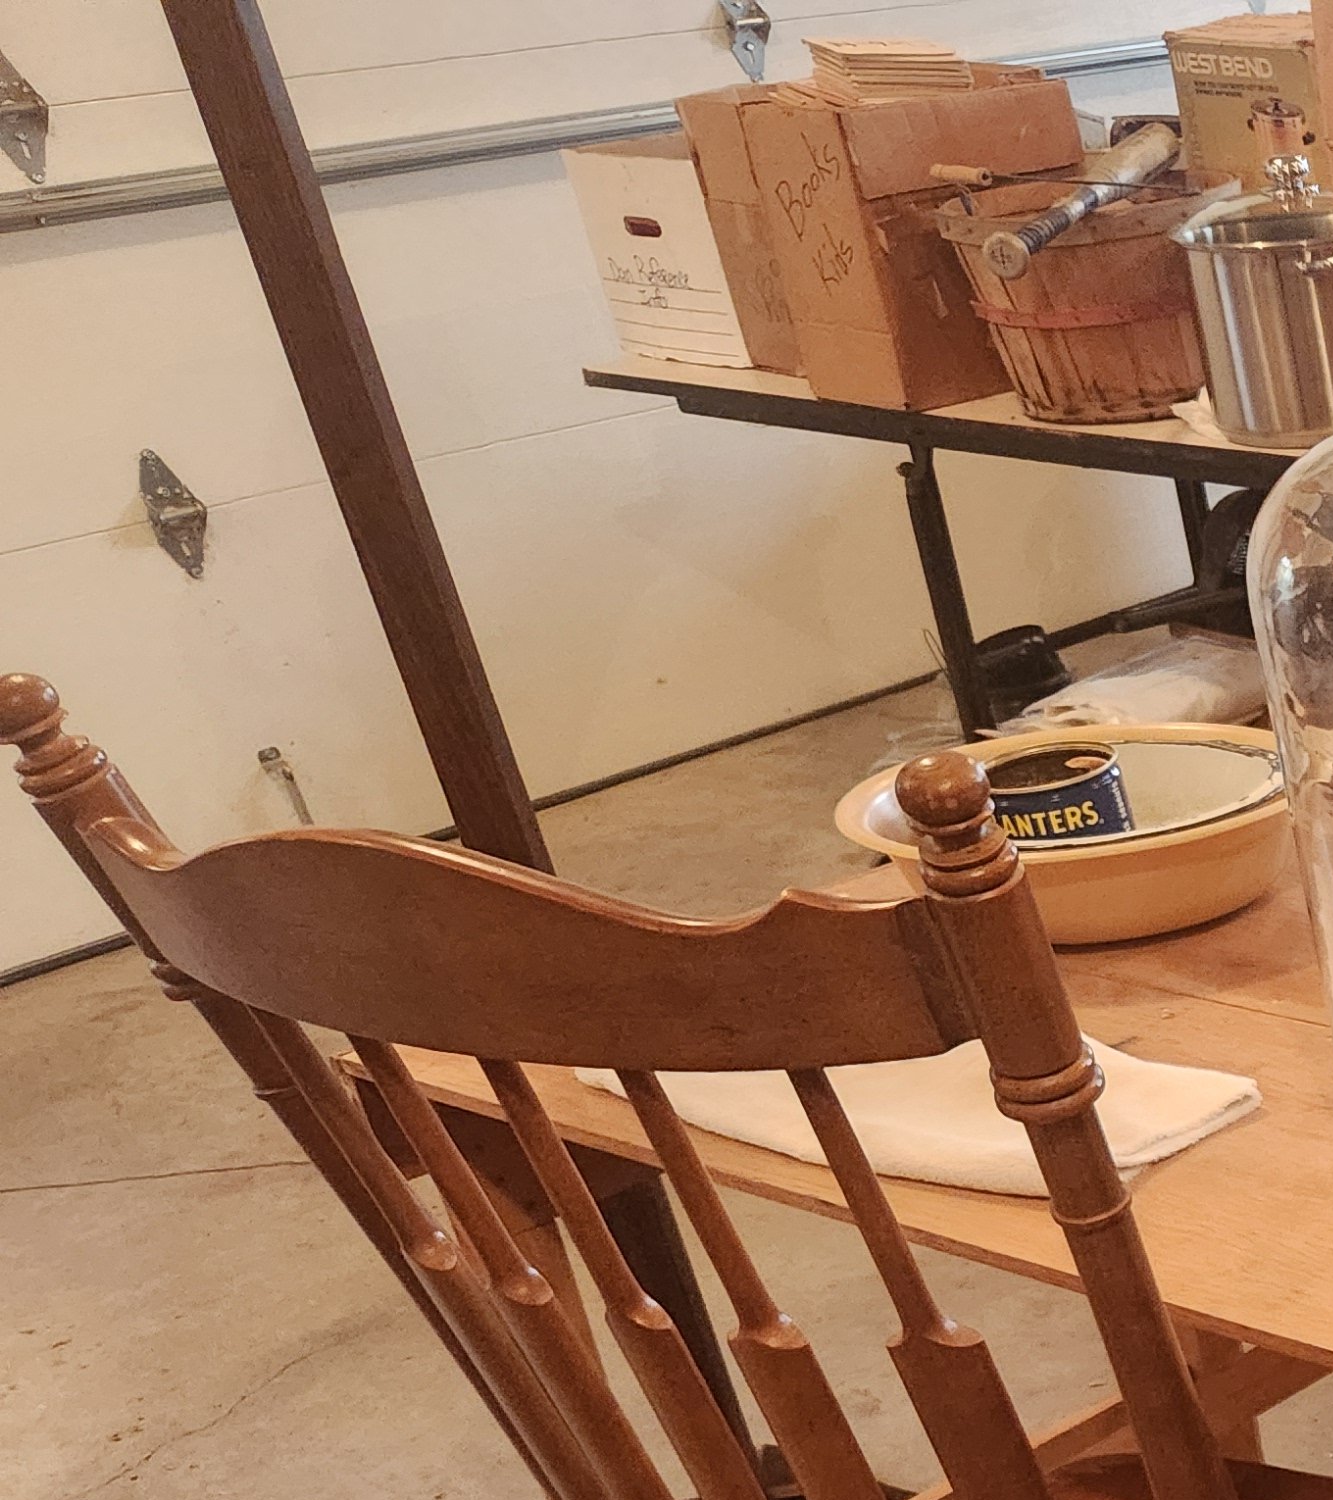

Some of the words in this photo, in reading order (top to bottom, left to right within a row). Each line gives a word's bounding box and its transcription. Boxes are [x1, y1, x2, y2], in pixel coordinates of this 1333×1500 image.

[1172, 49, 1217, 76] WEST
[1219, 54, 1274, 80] BEND
[774, 131, 840, 243] Books
[811, 222, 854, 298] Kids
[1000, 800, 1099, 837] ANTERS
